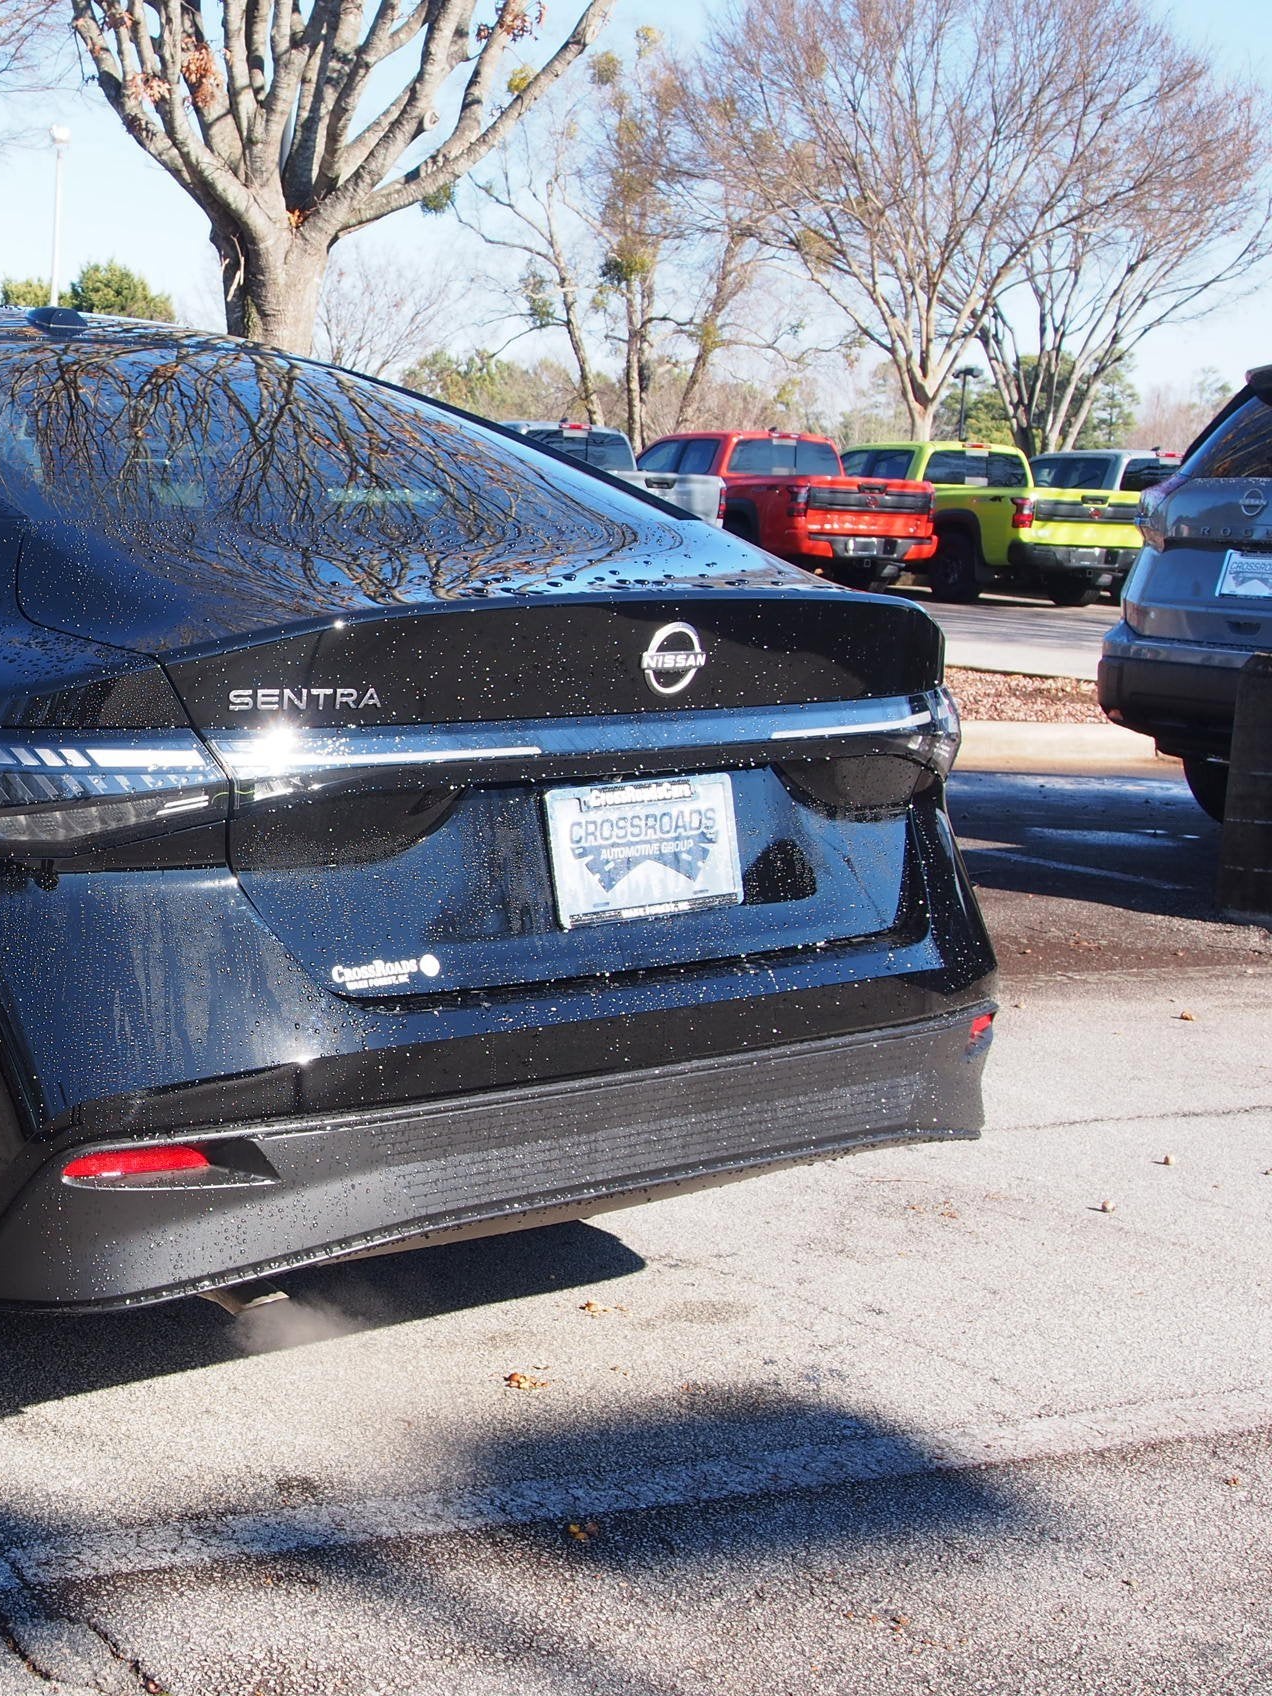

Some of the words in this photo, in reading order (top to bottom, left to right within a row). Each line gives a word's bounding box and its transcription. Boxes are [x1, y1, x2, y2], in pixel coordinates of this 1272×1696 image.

[642, 653, 706, 669] NISSAN
[228, 687, 382, 711] SENTRA
[569, 807, 718, 845] CROSSROADS
[600, 844, 660, 859] AUTOMOTIVE
[661, 839, 694, 854] GROUP
